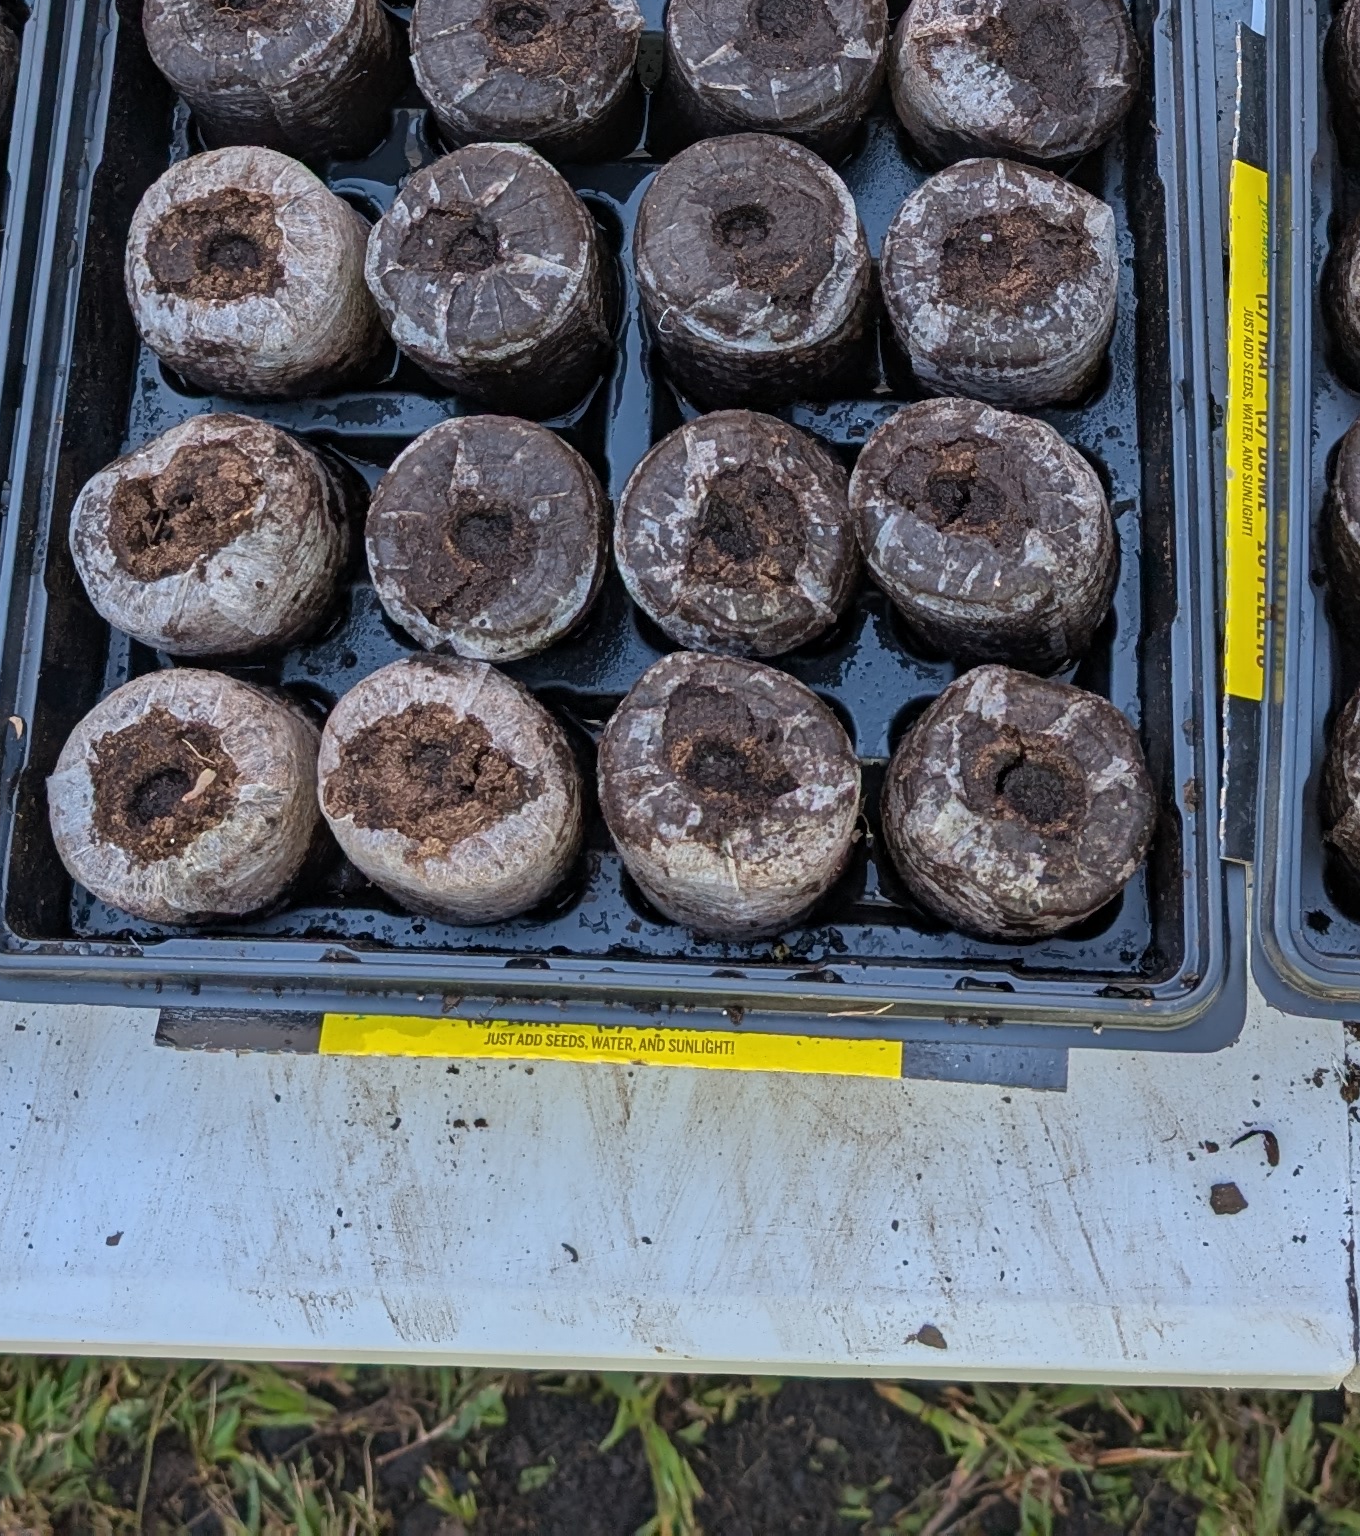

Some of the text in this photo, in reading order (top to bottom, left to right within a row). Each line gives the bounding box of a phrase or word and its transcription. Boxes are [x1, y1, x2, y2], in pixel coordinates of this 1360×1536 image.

[1242, 306, 1254, 537] JUST ADD SEEDS, WATER, AND SUNLIGHT!
[484, 1032, 735, 1055] JUST ADD SEEDS, WATER, AND SUNLIGHT!
